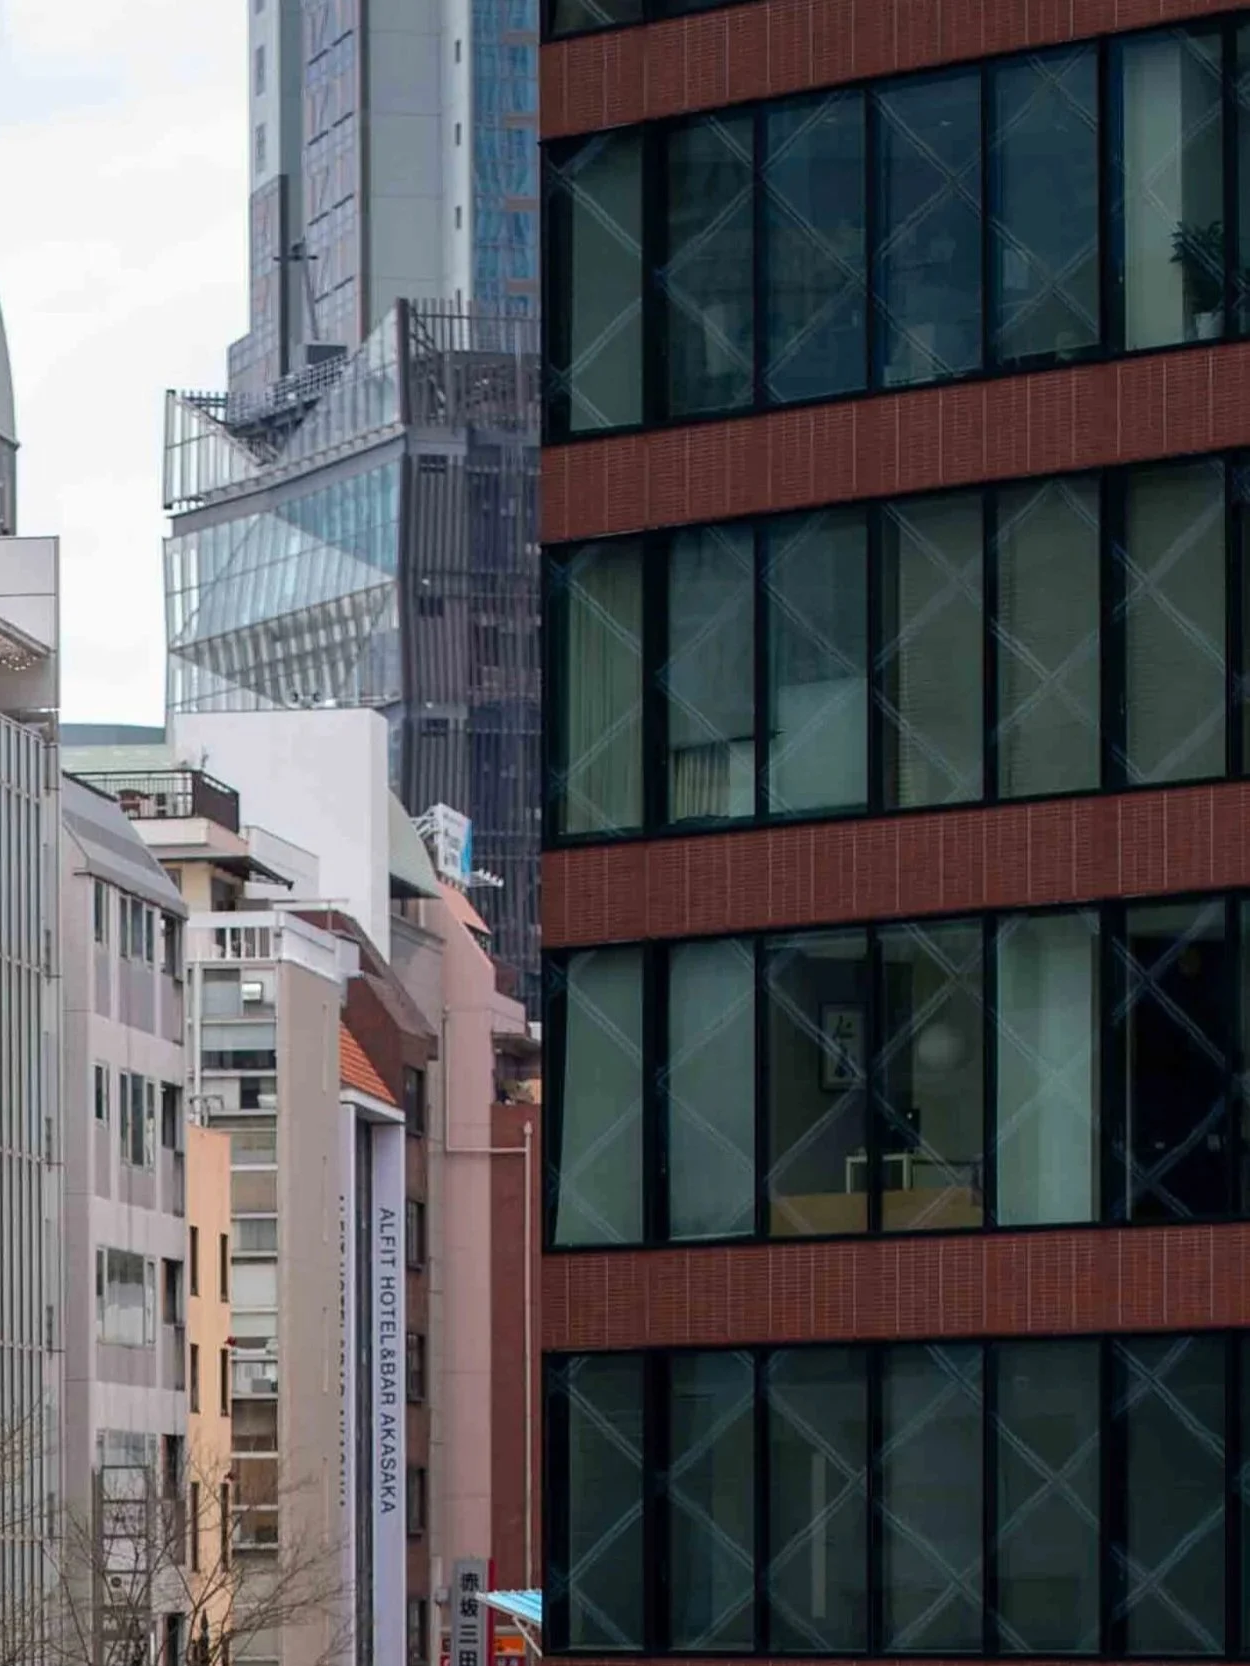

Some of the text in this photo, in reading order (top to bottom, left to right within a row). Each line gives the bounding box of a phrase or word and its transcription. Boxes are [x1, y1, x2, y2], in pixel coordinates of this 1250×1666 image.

[379, 1207, 396, 1514] ALFIT HOTEL&BAR AKASAKA
